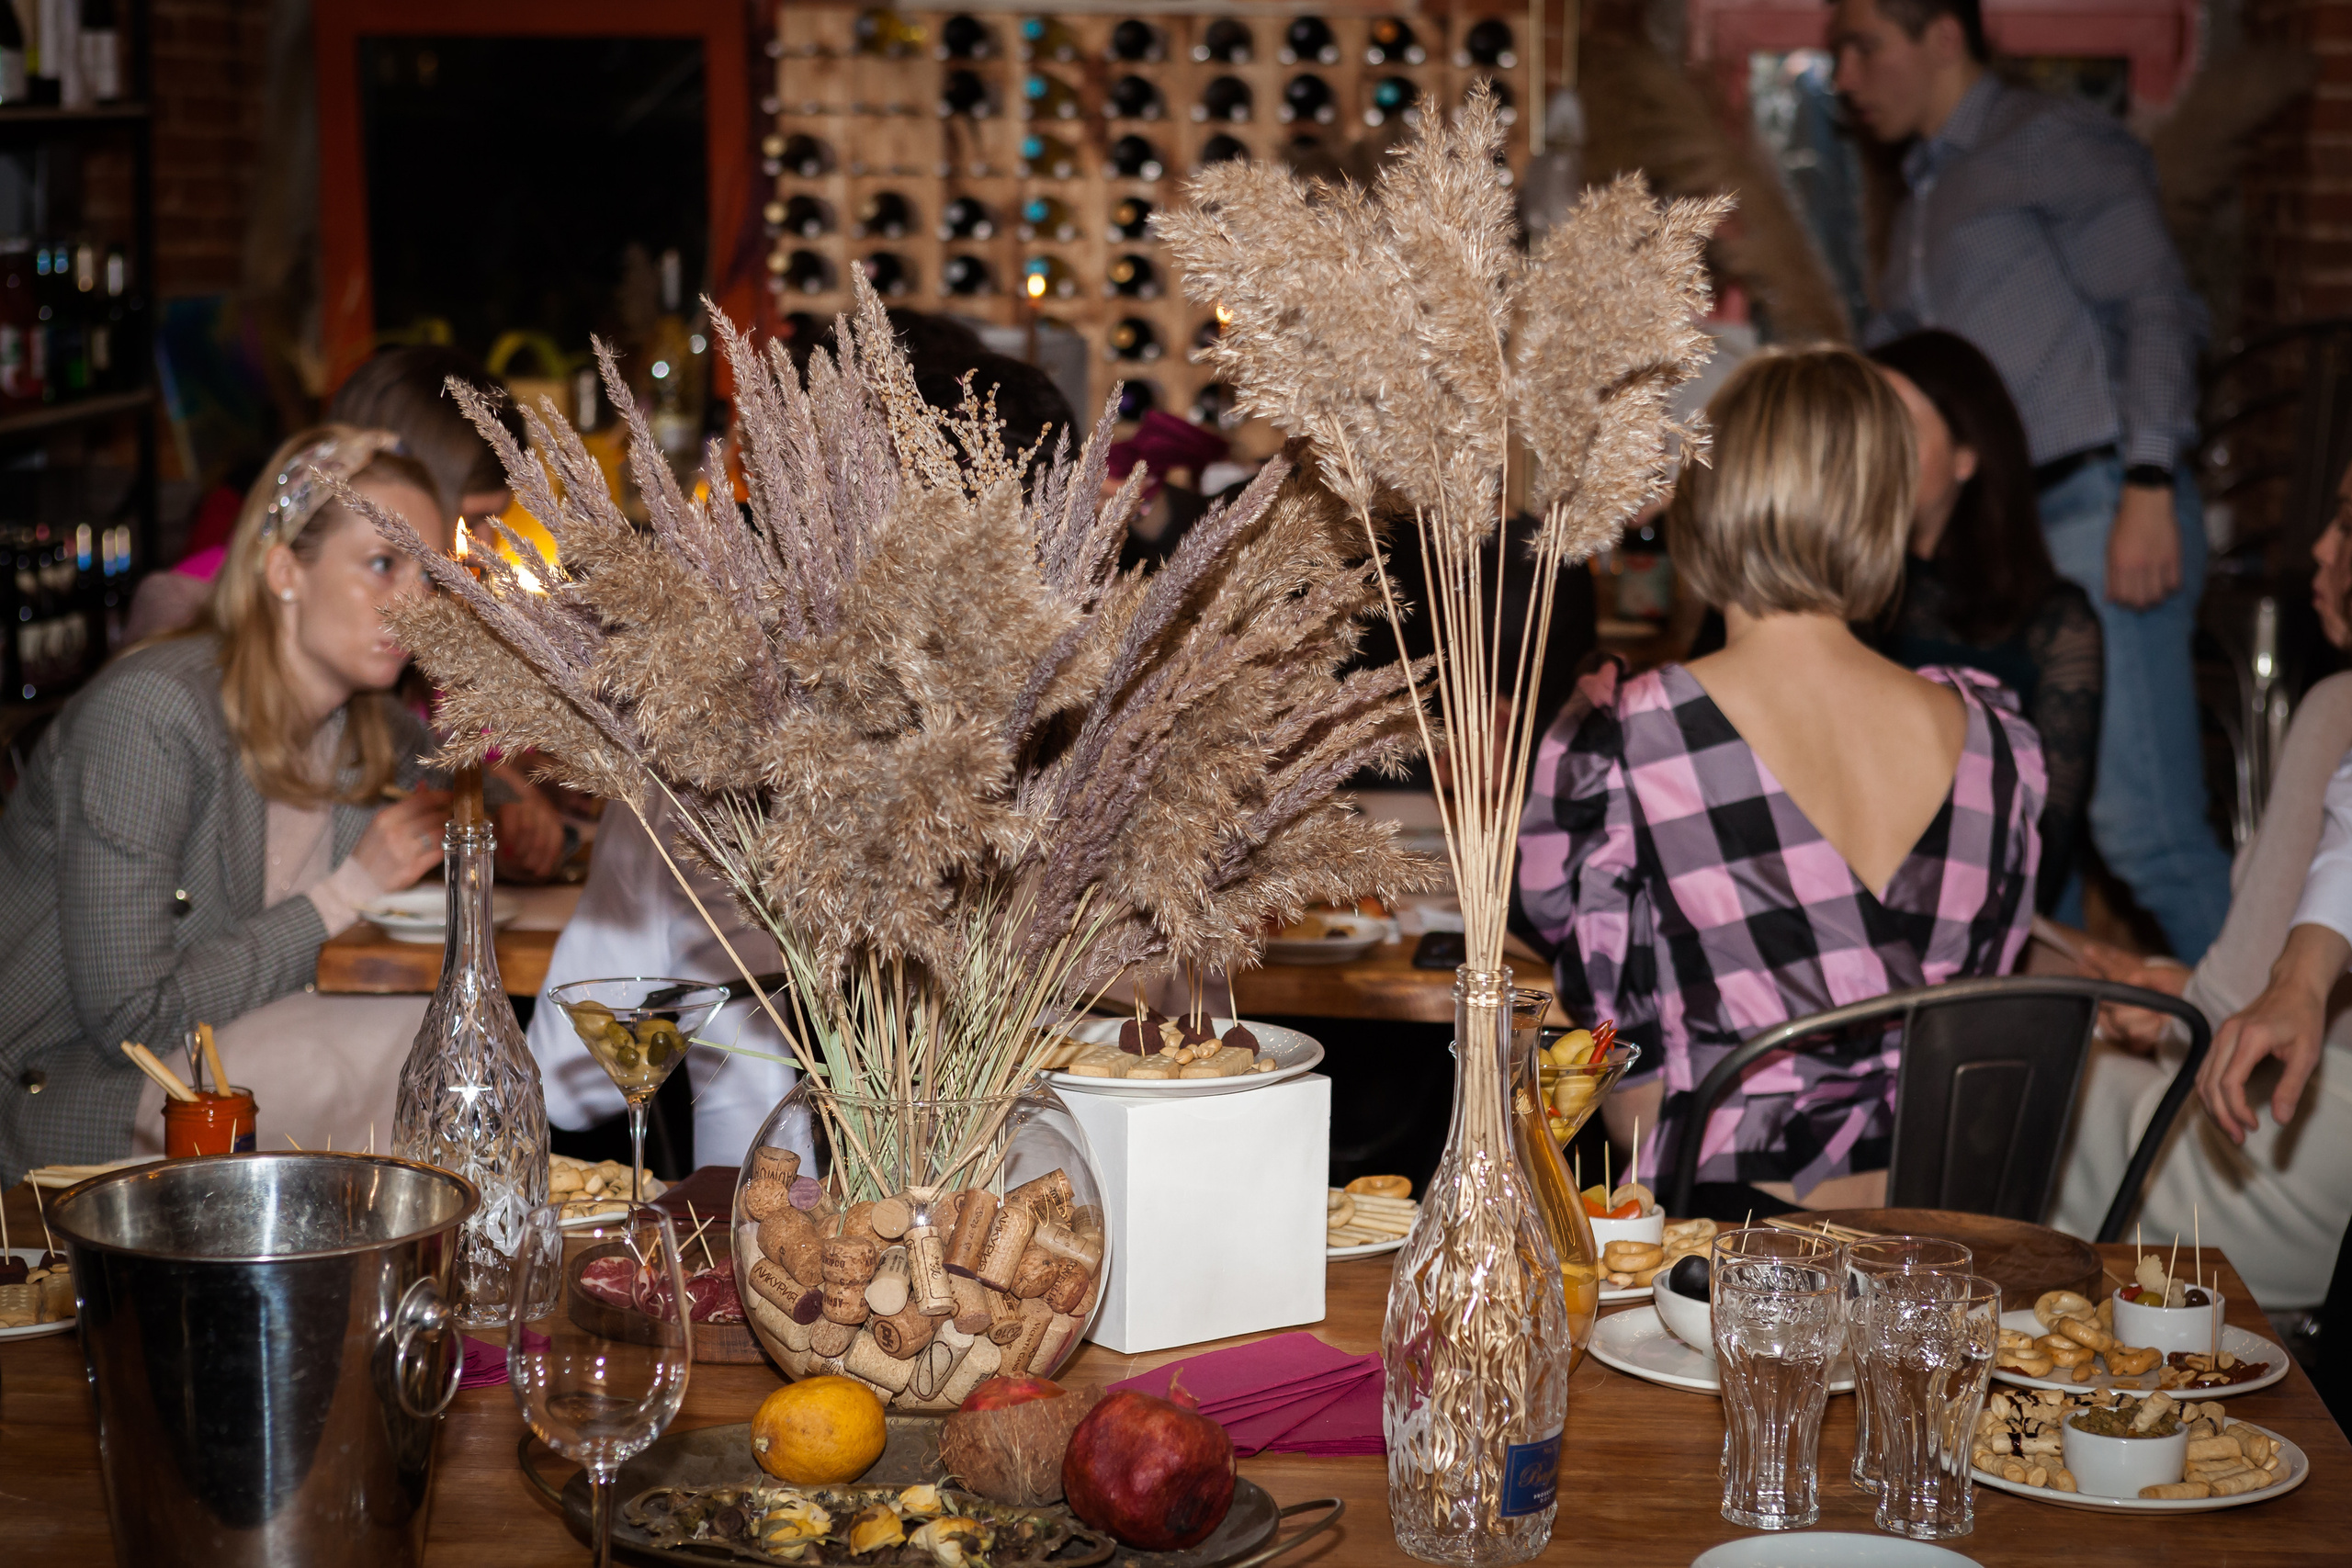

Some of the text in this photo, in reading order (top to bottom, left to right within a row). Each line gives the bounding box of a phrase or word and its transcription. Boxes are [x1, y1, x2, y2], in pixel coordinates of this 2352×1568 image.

[979, 1211, 1009, 1272] ЛИКУРИЯ
[754, 1266, 798, 1303] ЛИКУРИЯ
[994, 1325, 1022, 1339] 2016
